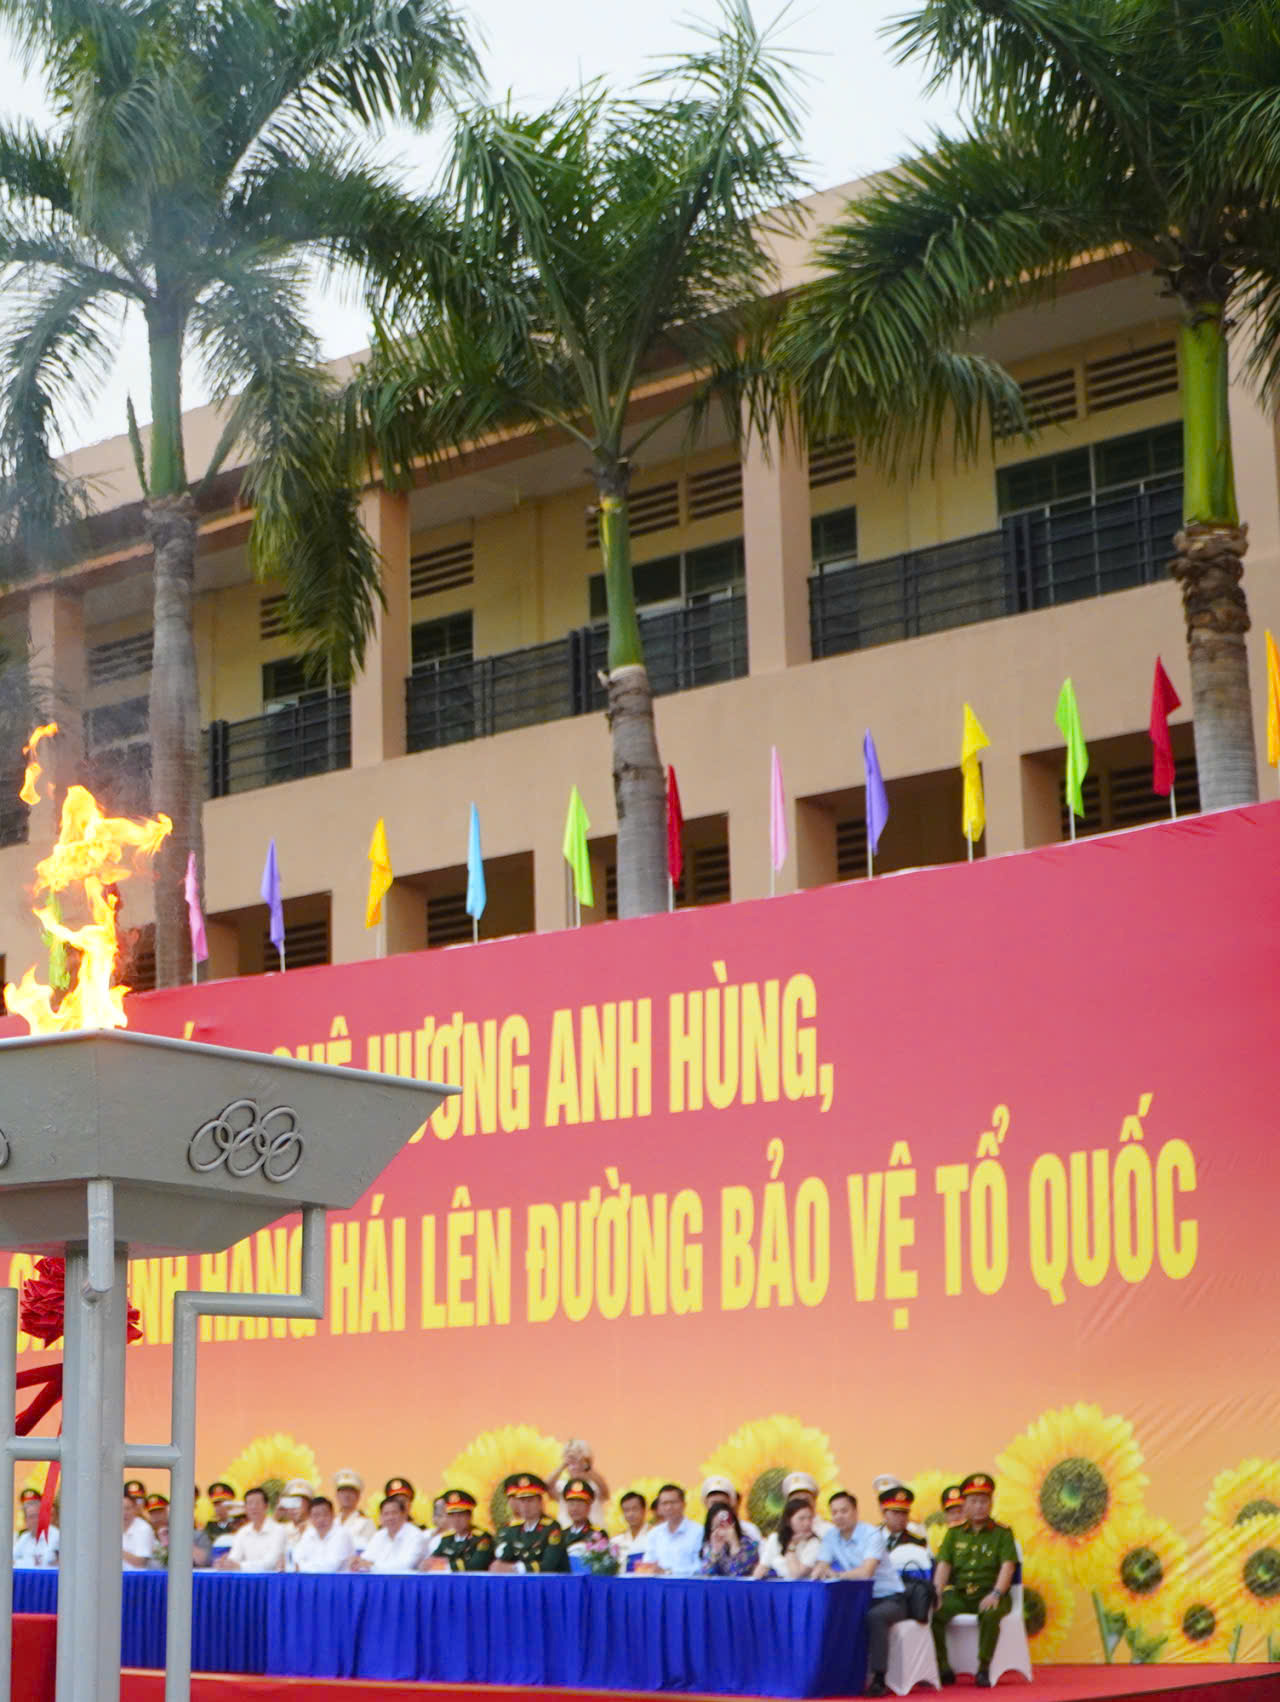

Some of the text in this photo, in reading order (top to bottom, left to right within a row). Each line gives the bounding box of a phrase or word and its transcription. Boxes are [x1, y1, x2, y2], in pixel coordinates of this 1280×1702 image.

[545, 998, 652, 1127] ANH
[669, 961, 834, 1113] HÙNG,
[330, 1193, 407, 1336] HÁI
[420, 1185, 513, 1330] LÊN
[525, 1167, 704, 1323] ĐƯỜNG
[721, 1137, 831, 1311] BẢO
[847, 1141, 919, 1331] VỆ
[935, 1104, 1010, 1297] TỔ
[1028, 1093, 1199, 1306] QUỐC
